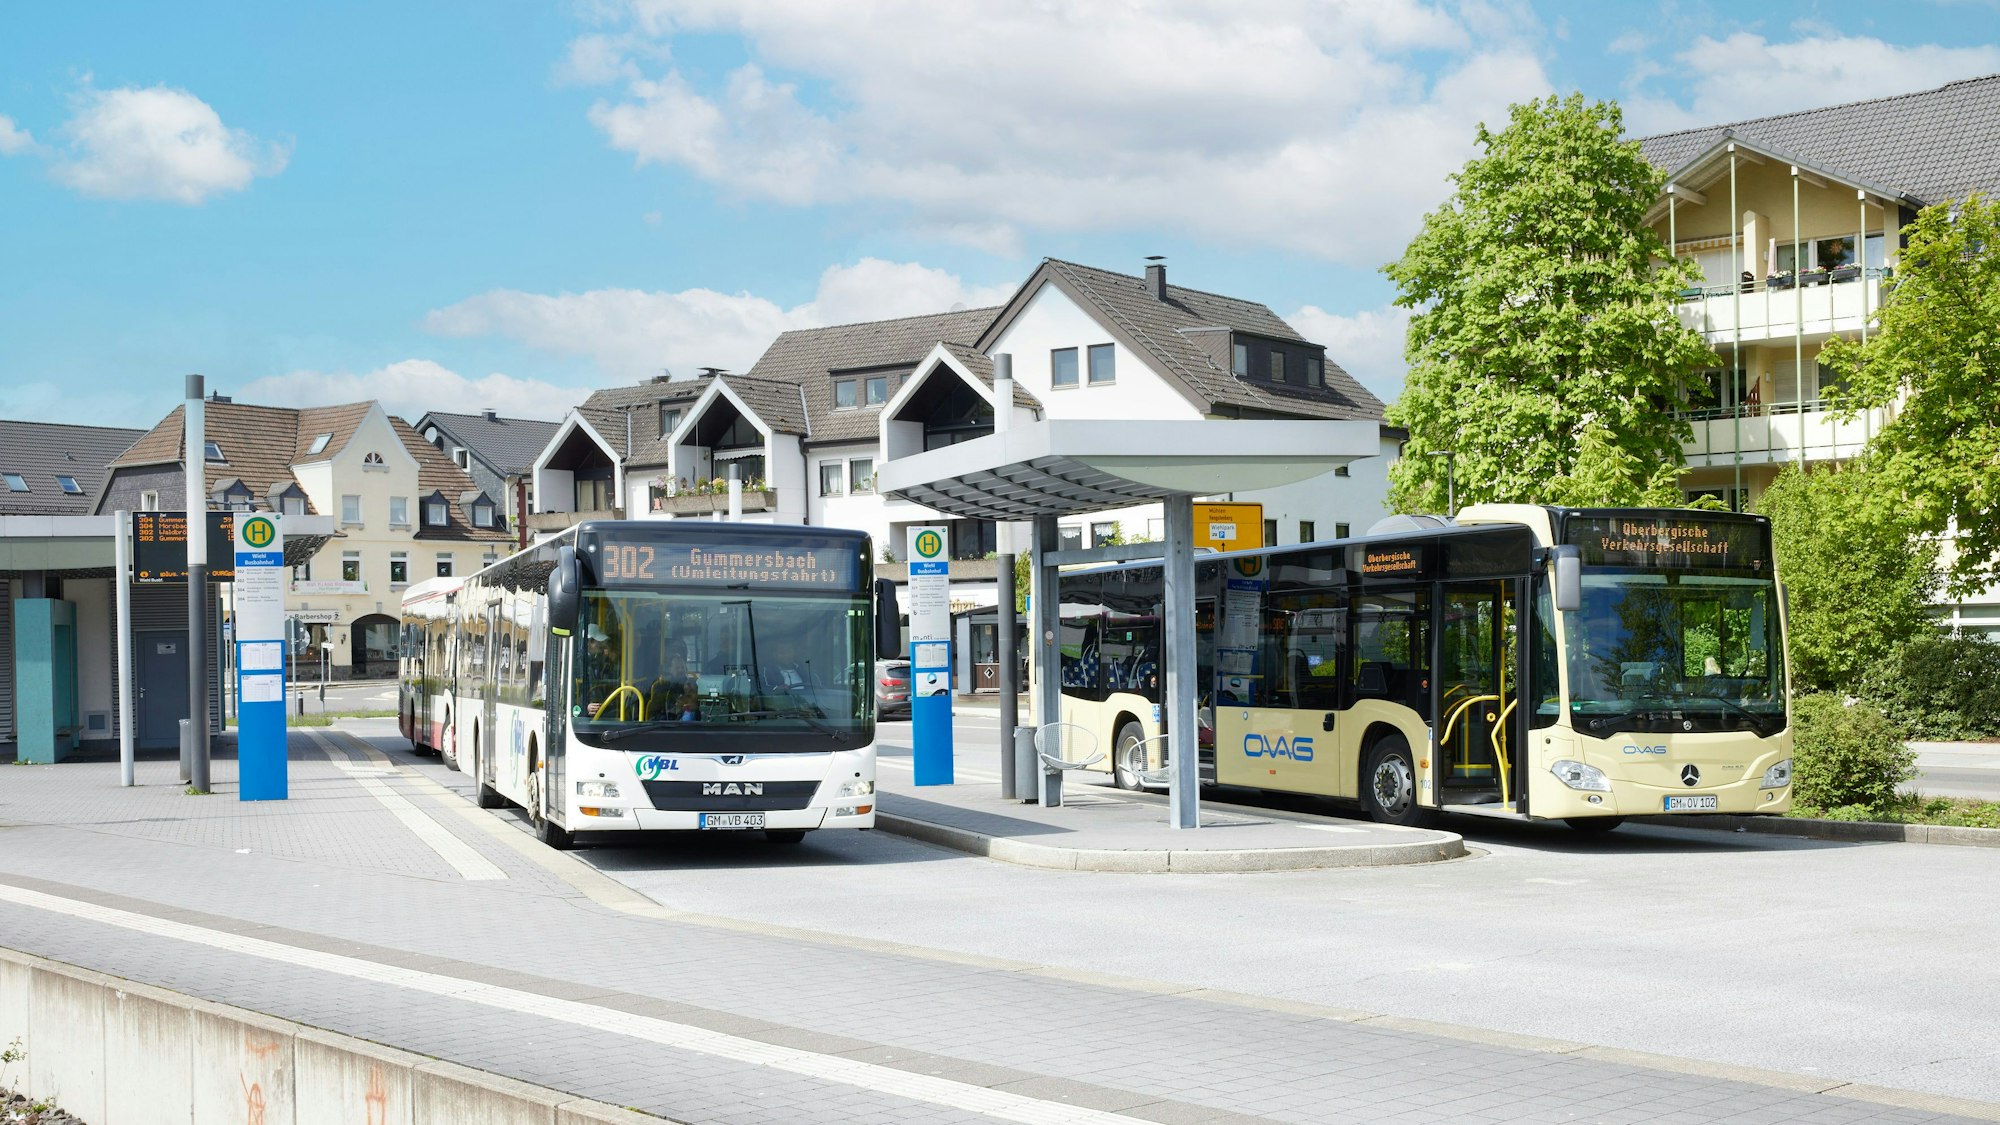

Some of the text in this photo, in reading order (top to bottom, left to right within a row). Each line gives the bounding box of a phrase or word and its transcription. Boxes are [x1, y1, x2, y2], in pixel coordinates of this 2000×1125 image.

[1622, 522, 1708, 540] Oberbergische
[1601, 537, 1729, 555] Verkehrsgesellschaft
[603, 545, 654, 579] 302
[690, 547, 816, 569] Gummersbach
[1367, 551, 1411, 563] Oberbergische
[671, 565, 837, 583] (Umleitungsfahrt)
[1362, 560, 1417, 573] Verkehrsgesellschaft
[1243, 733, 1314, 763] OVAG
[1623, 745, 1667, 755] OVAG
[646, 755, 679, 771] VBL
[702, 782, 764, 796] MAN
[1420, 780, 1431, 789] 102
[1670, 798, 1716, 809] GM OV 102
[706, 815, 763, 827] GM VB 403
